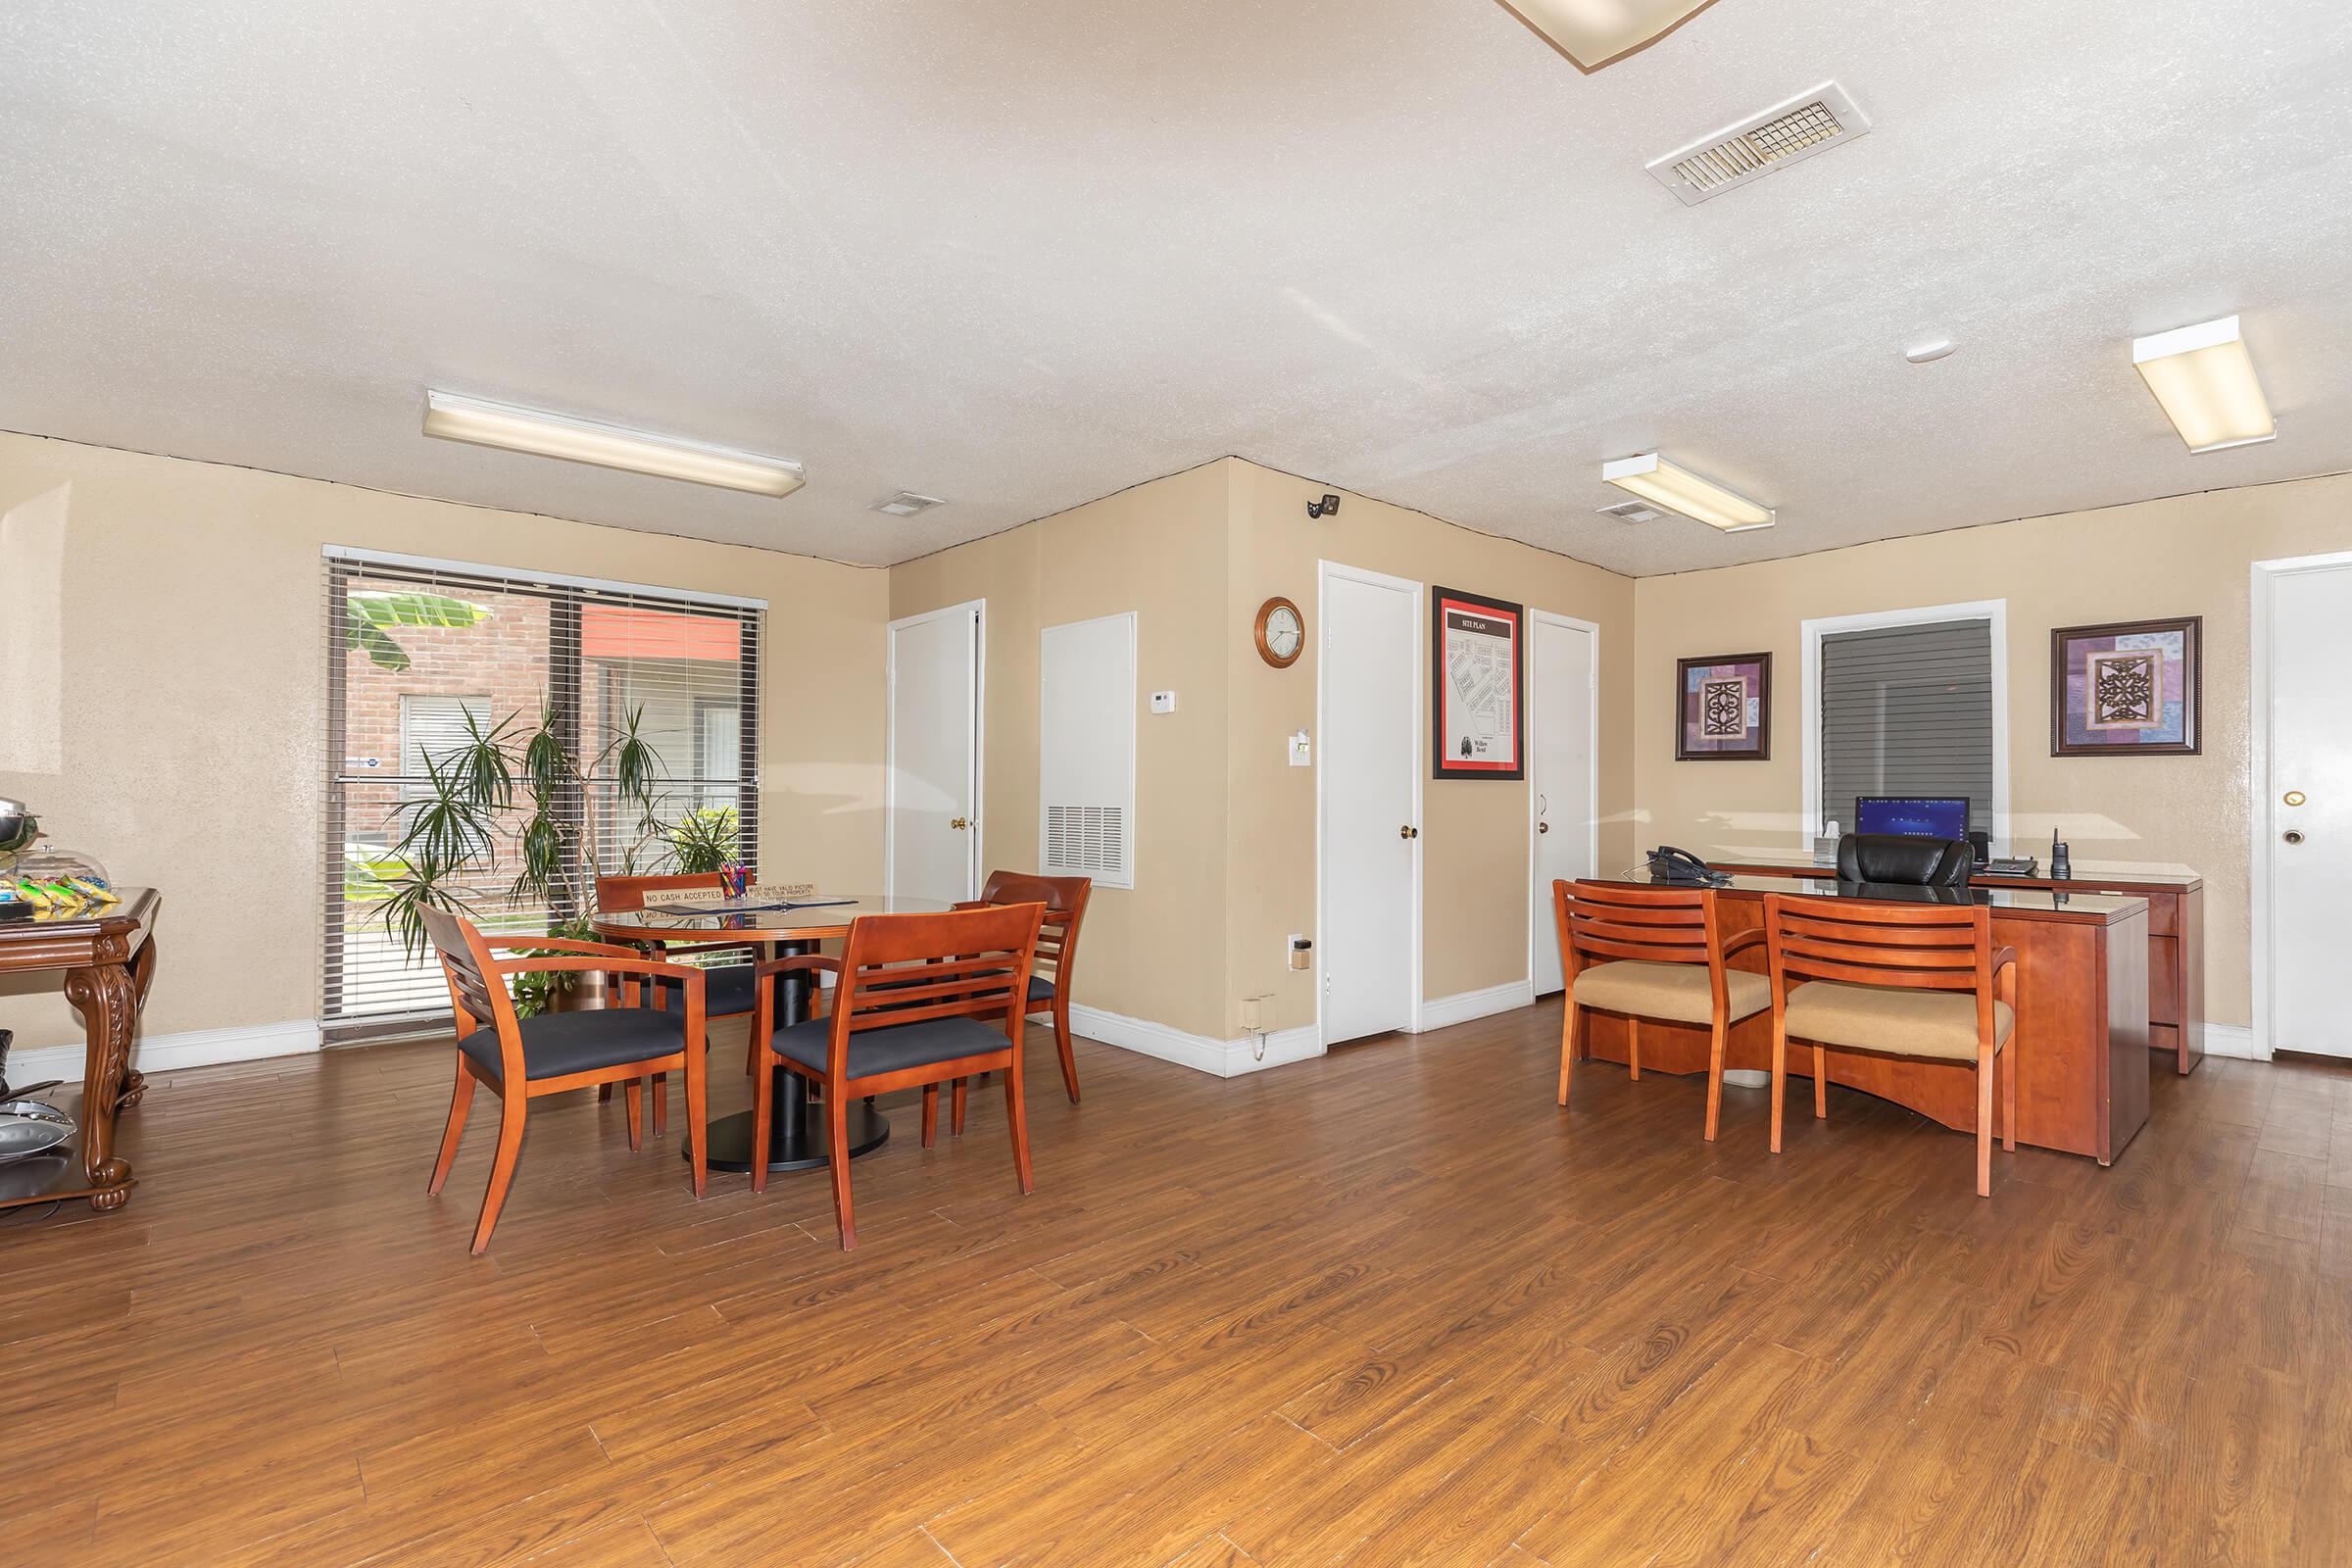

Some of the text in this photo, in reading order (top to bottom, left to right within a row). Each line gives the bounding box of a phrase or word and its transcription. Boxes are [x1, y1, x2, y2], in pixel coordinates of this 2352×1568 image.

[1462, 619, 1486, 630] SITE PLAN
[646, 891, 721, 903] NO CASH ACCEPTED
